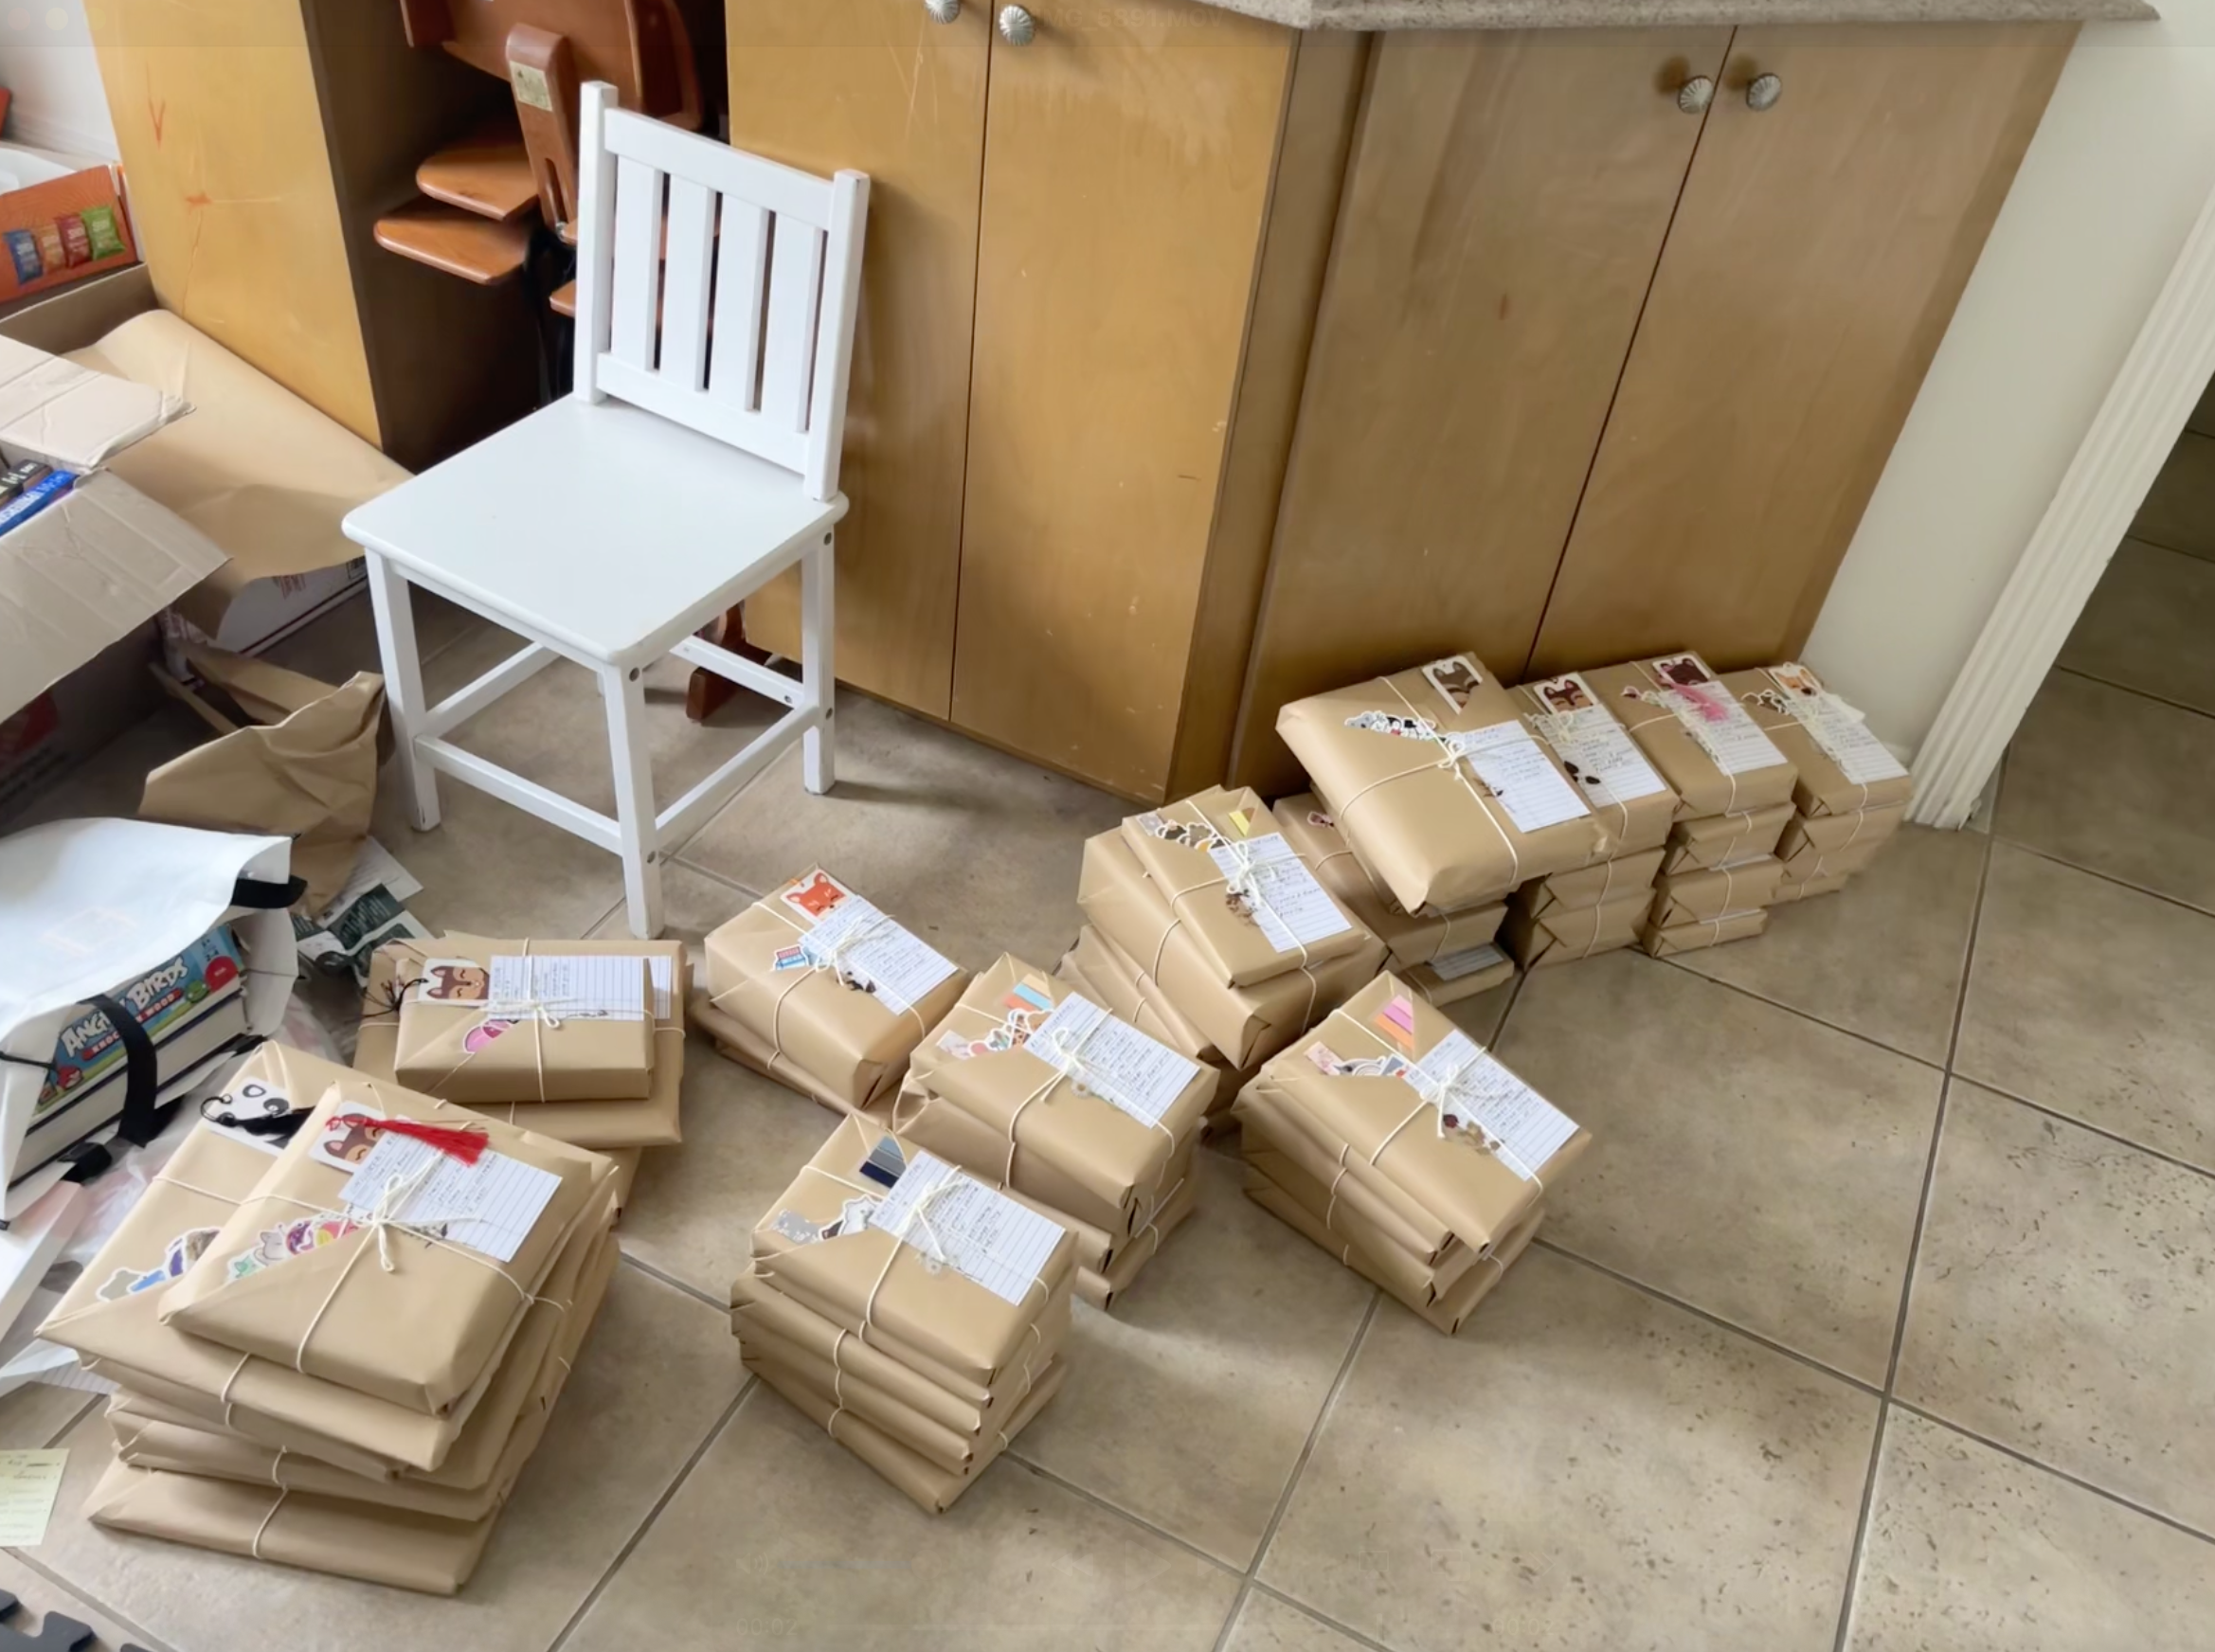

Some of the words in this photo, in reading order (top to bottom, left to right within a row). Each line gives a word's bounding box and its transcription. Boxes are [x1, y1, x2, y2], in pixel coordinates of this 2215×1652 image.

[127, 957, 188, 1009] BIRDS
[92, 1032, 120, 1053] KNOC
[145, 991, 176, 1018] WOOD
